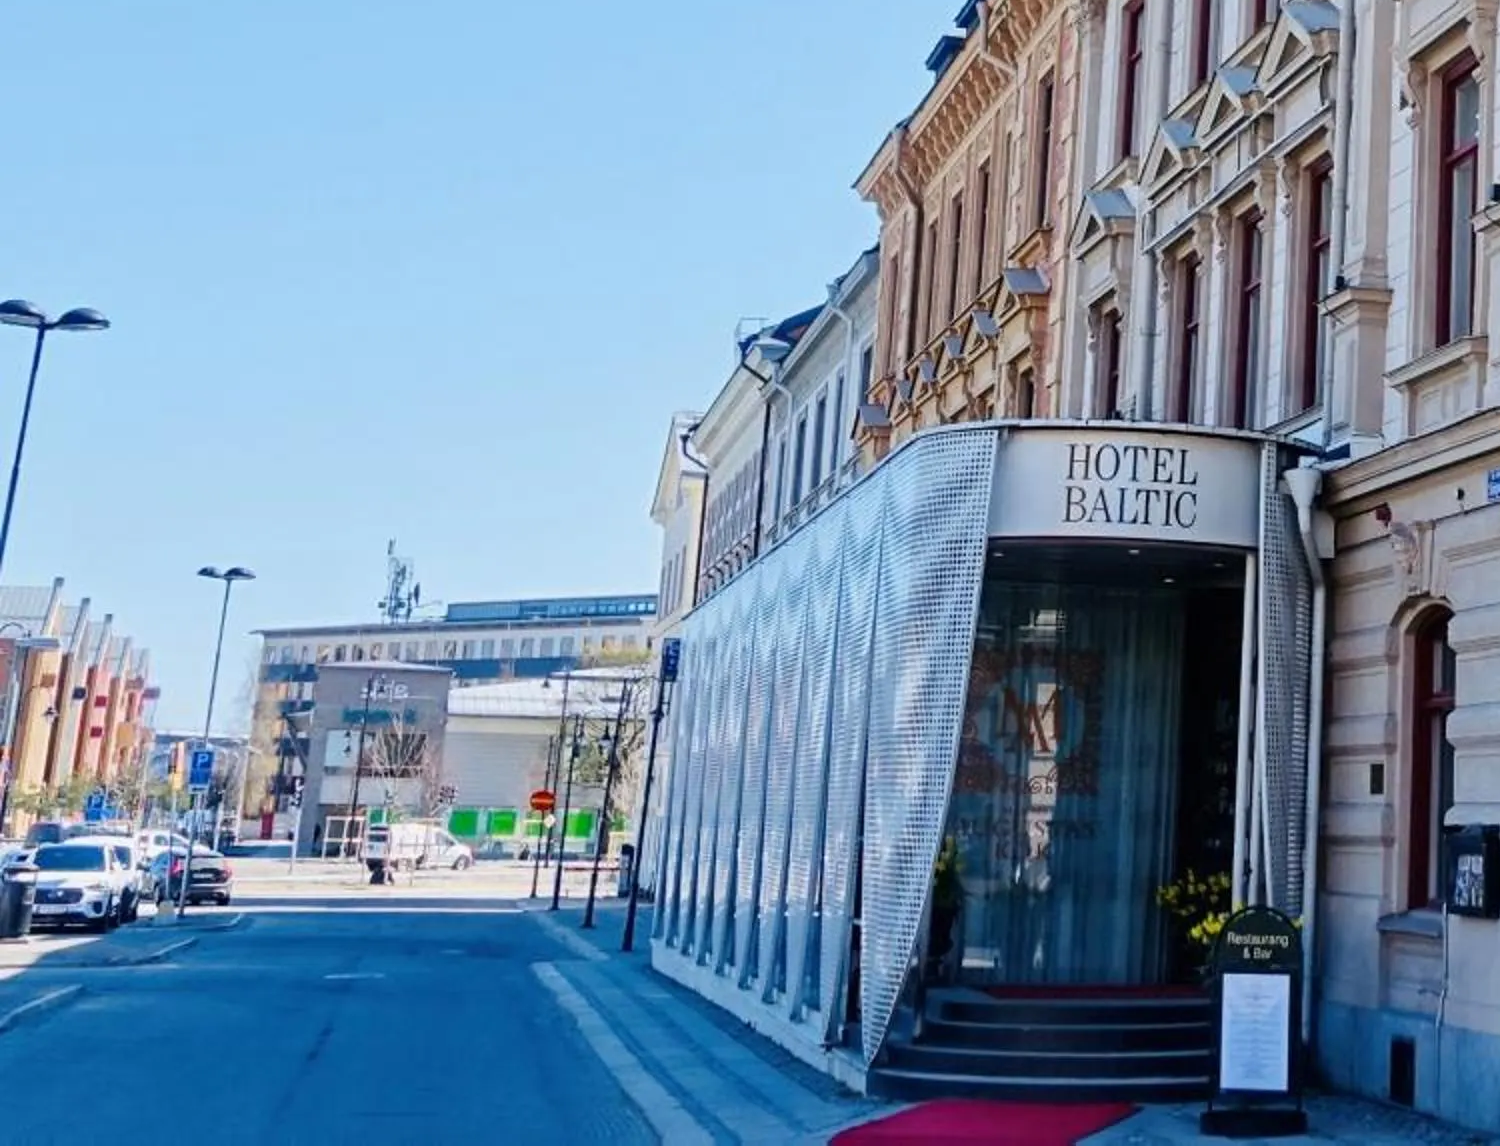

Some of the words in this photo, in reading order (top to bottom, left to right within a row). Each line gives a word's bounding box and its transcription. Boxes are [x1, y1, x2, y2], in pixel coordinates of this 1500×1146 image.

[1066, 443, 1199, 485] HOTEL
[1062, 485, 1198, 529] BALTIC
[1227, 931, 1289, 948] Restaurang
[1254, 948, 1273, 959] Bar
